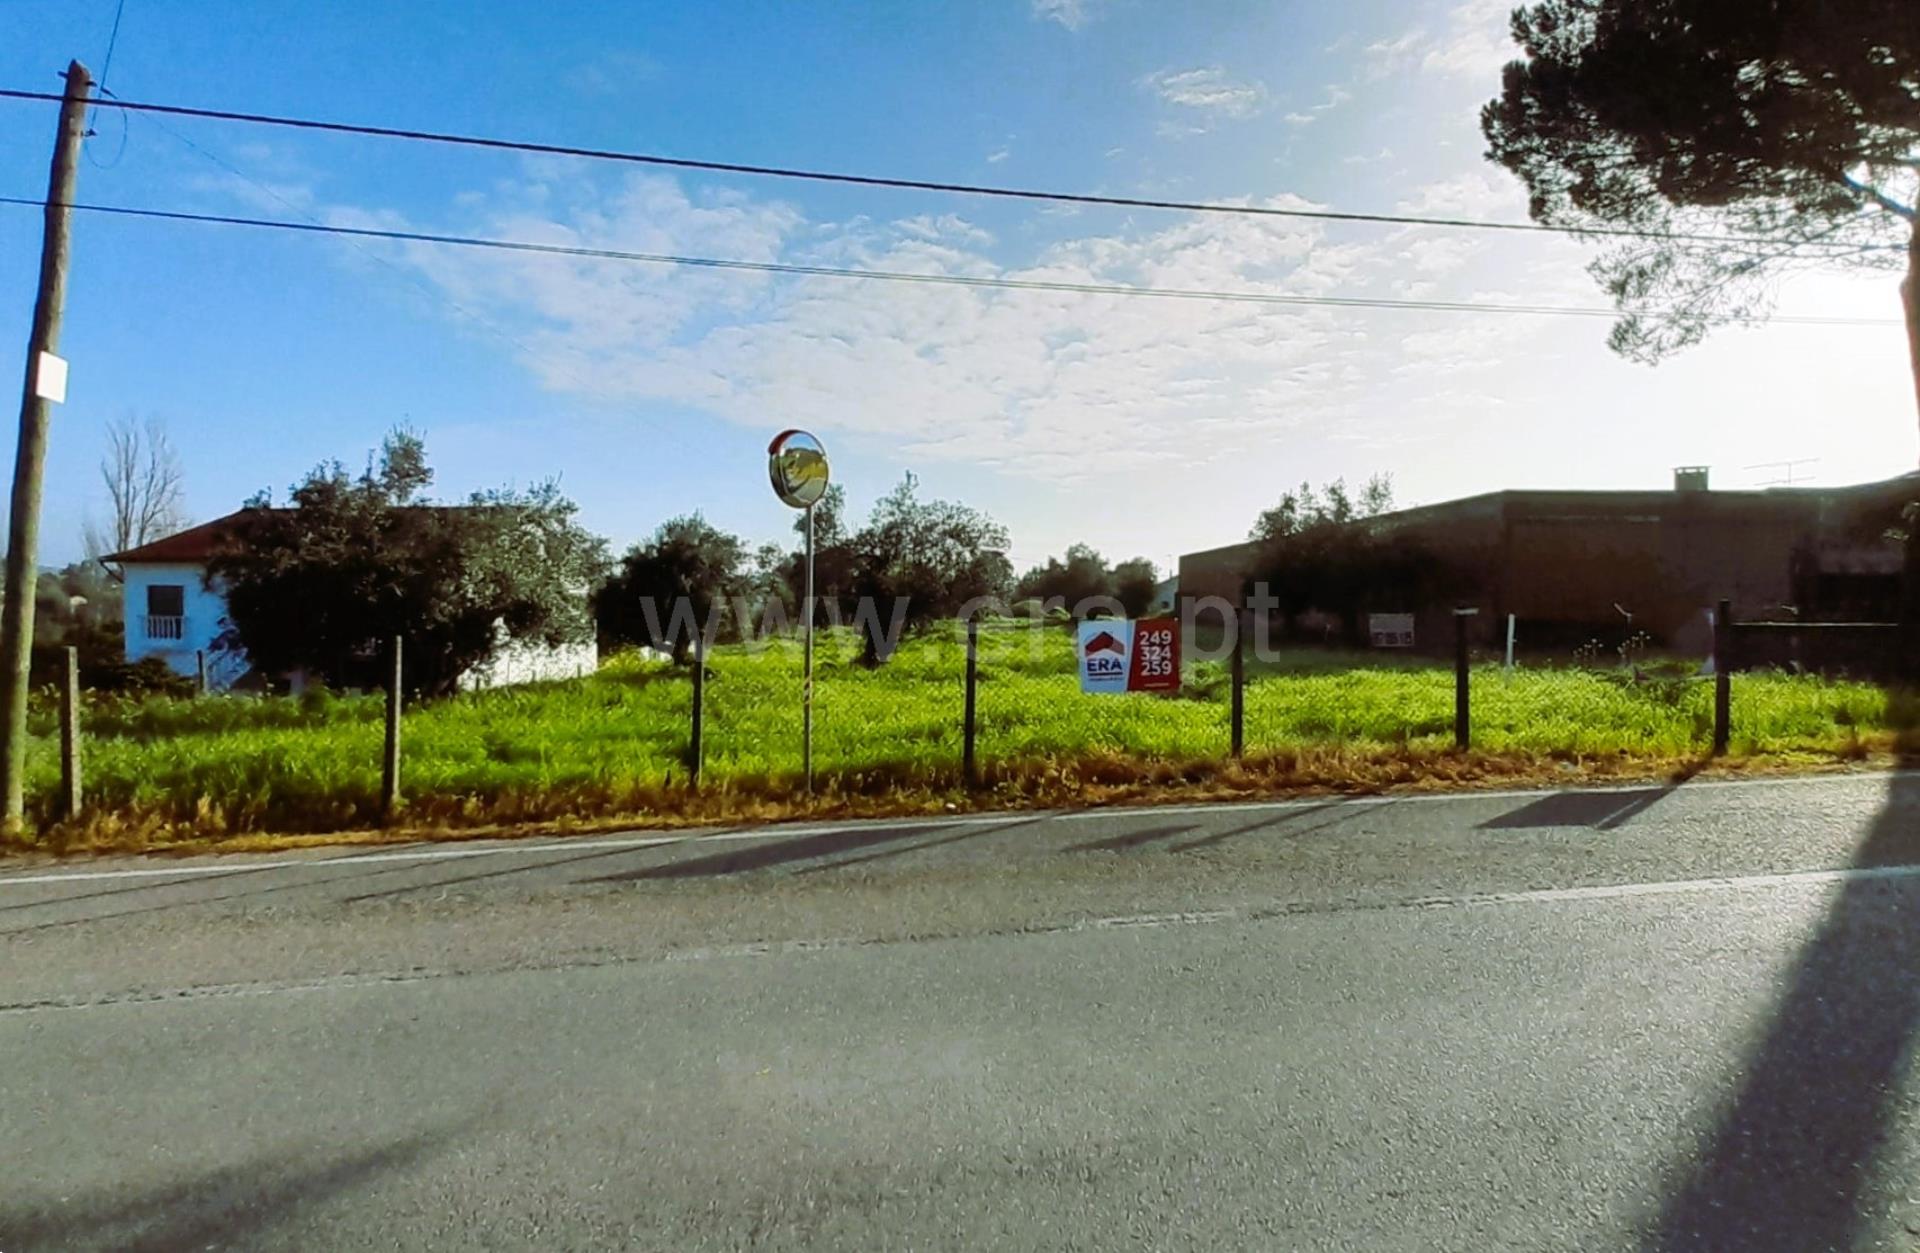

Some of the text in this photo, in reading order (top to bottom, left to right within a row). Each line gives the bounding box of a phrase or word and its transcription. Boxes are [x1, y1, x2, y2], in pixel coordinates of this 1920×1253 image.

[1140, 630, 1172, 645] 249
[1140, 645, 1171, 660] 324
[1086, 658, 1122, 672] ERA
[1141, 661, 1172, 676] 259
